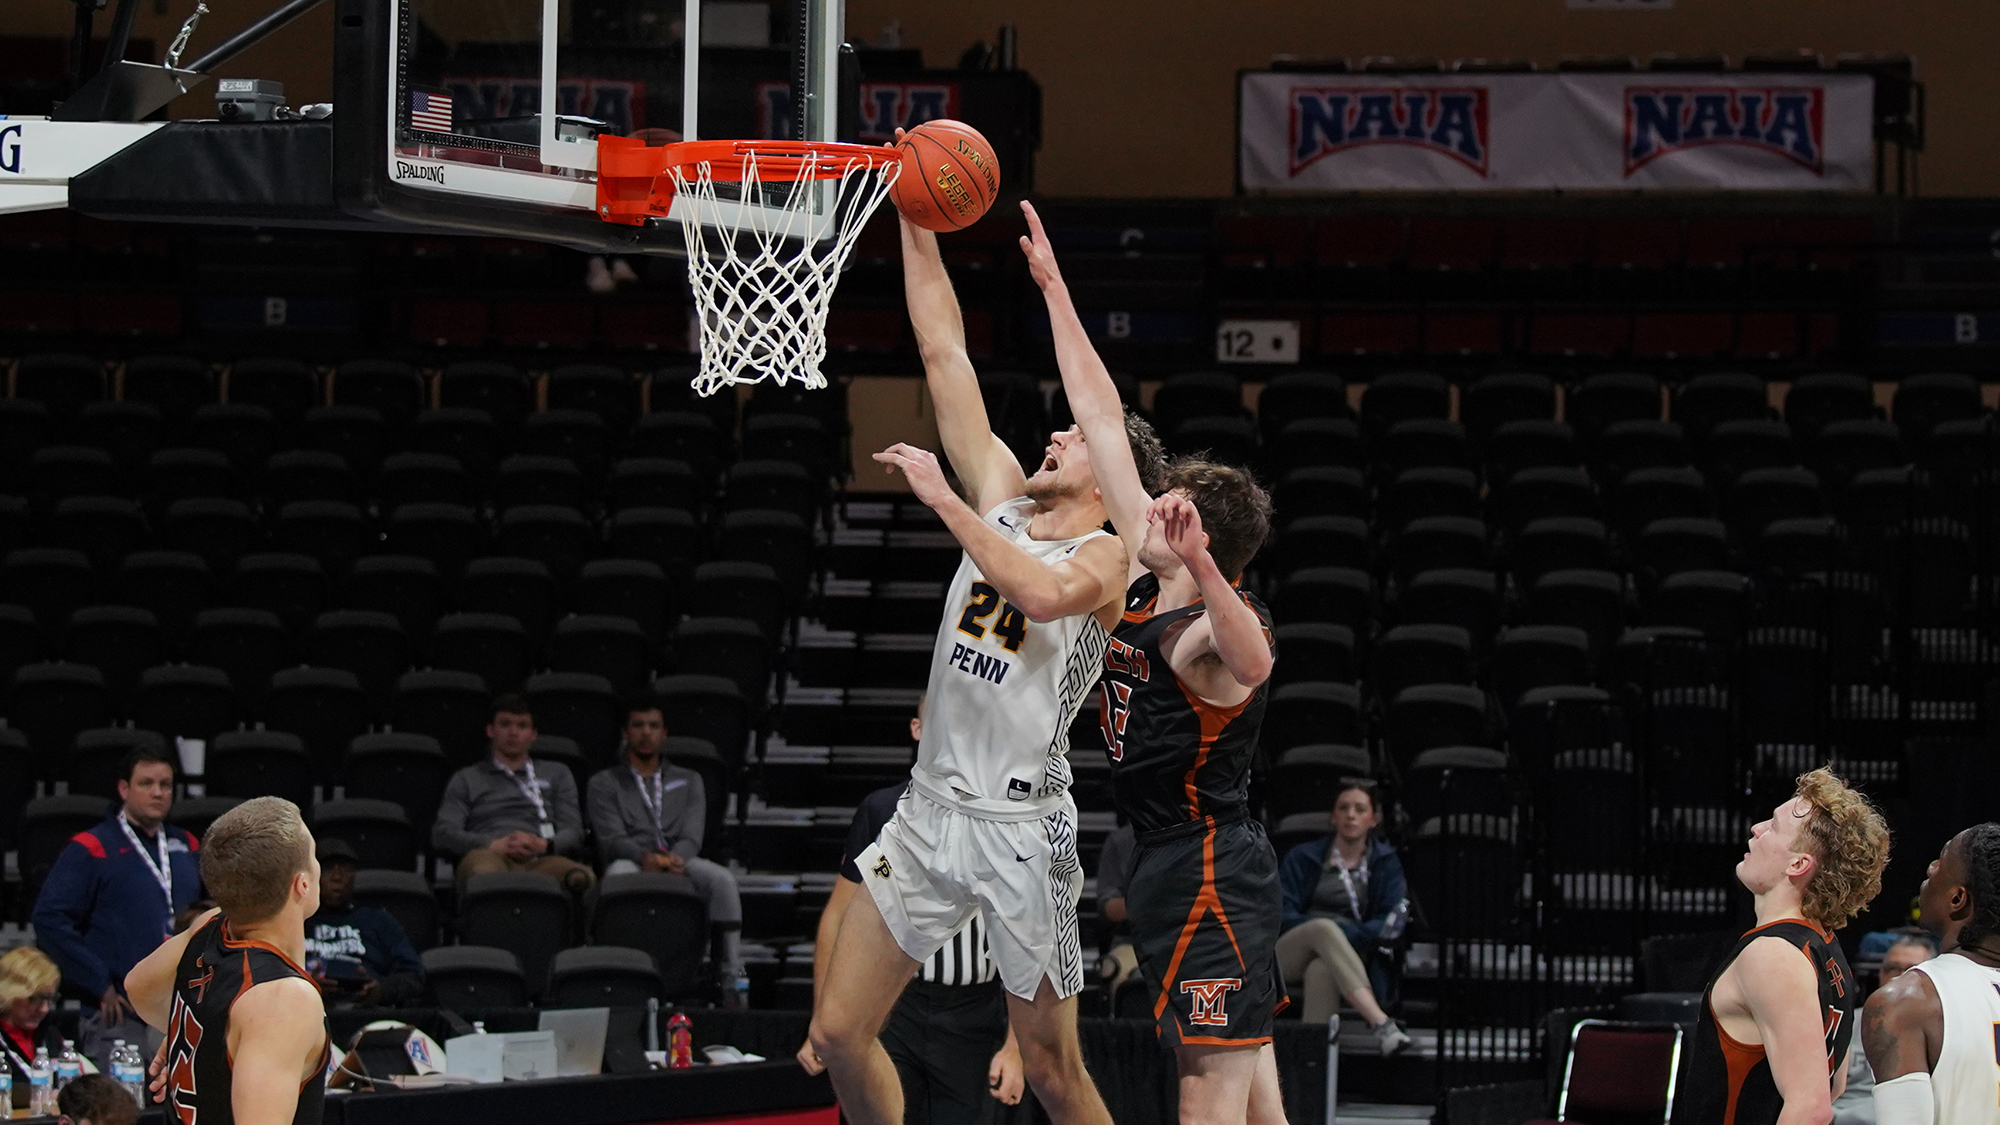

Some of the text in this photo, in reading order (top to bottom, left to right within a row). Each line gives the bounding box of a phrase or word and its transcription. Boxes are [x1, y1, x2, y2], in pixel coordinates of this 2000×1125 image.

[1297, 95, 1481, 160] NAIA
[1632, 95, 1815, 160] NAIA
[396, 160, 444, 184] SPALDING
[265, 296, 287, 326] B
[1107, 311, 1132, 339] B
[1955, 313, 1979, 343] B
[1222, 329, 1254, 359] 12
[956, 580, 1028, 654] 24
[949, 642, 1011, 685] PENN
[1104, 635, 1151, 683] CH
